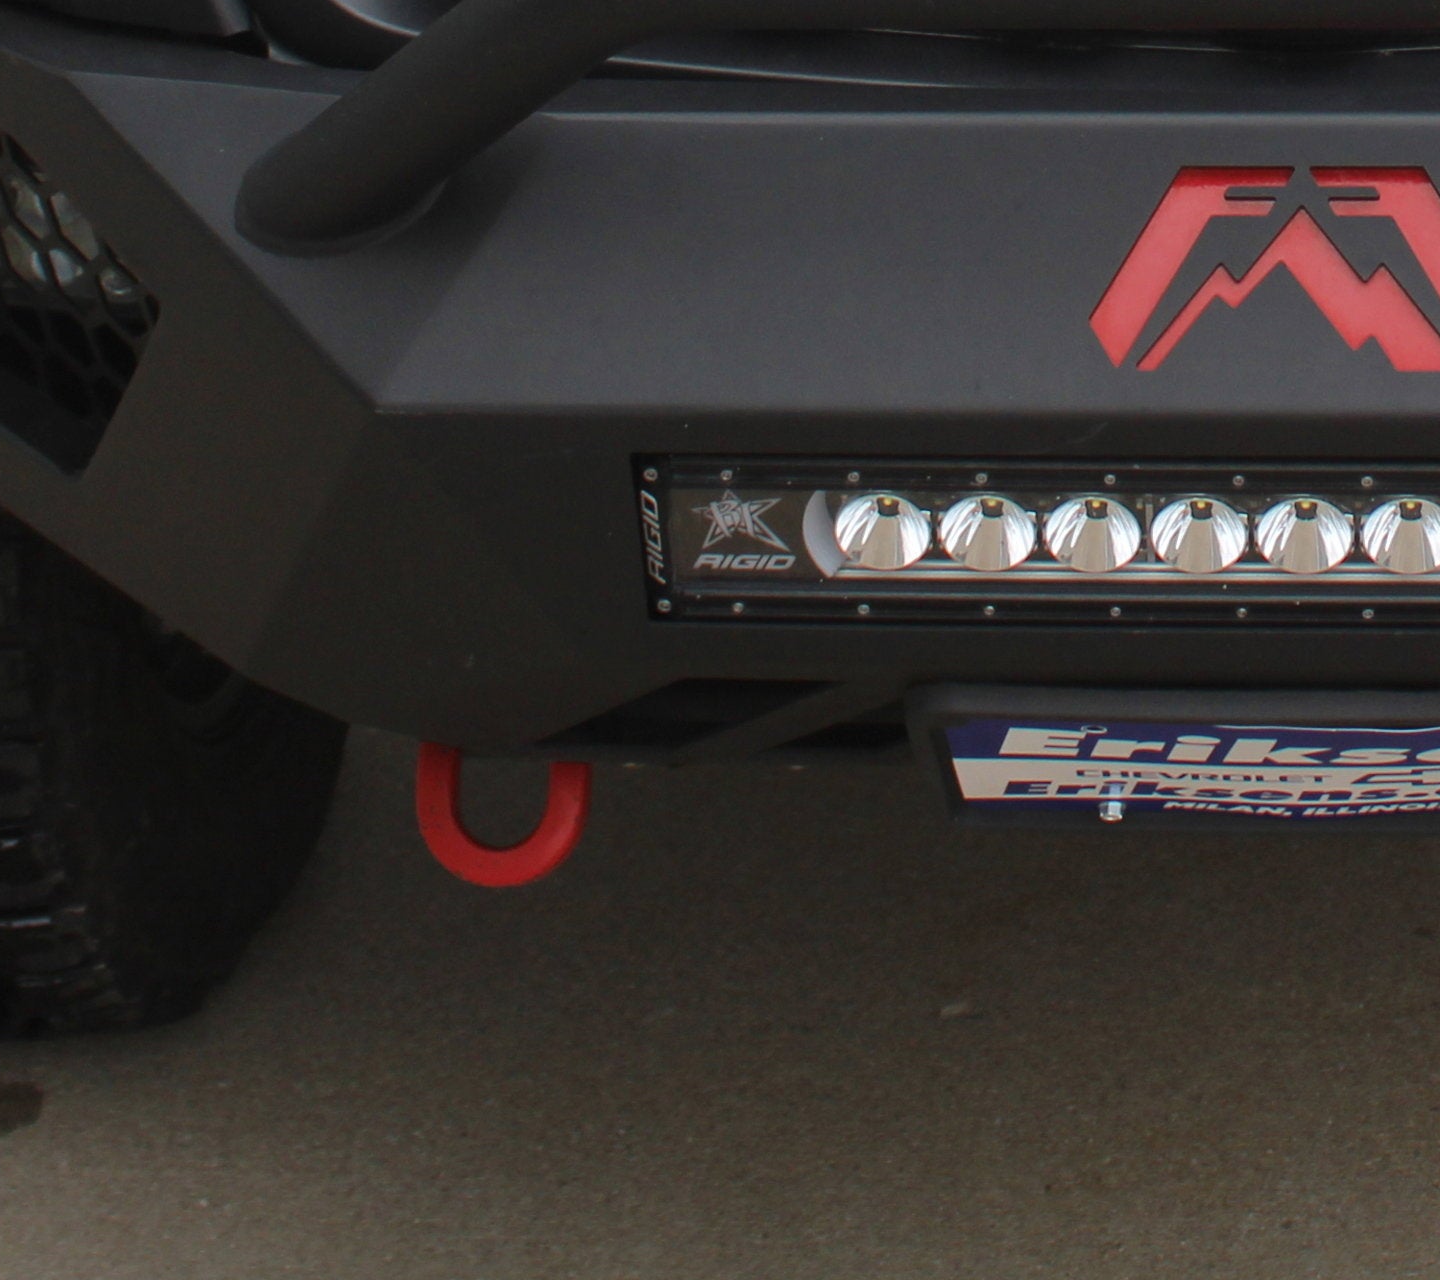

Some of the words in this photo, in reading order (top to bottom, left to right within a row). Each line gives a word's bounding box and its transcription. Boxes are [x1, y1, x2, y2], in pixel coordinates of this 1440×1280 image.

[640, 489, 667, 585] RIGID
[693, 553, 797, 570] RIGID
[1075, 769, 1333, 784] CHEVROLET
[1162, 800, 1292, 817] MILAN,
